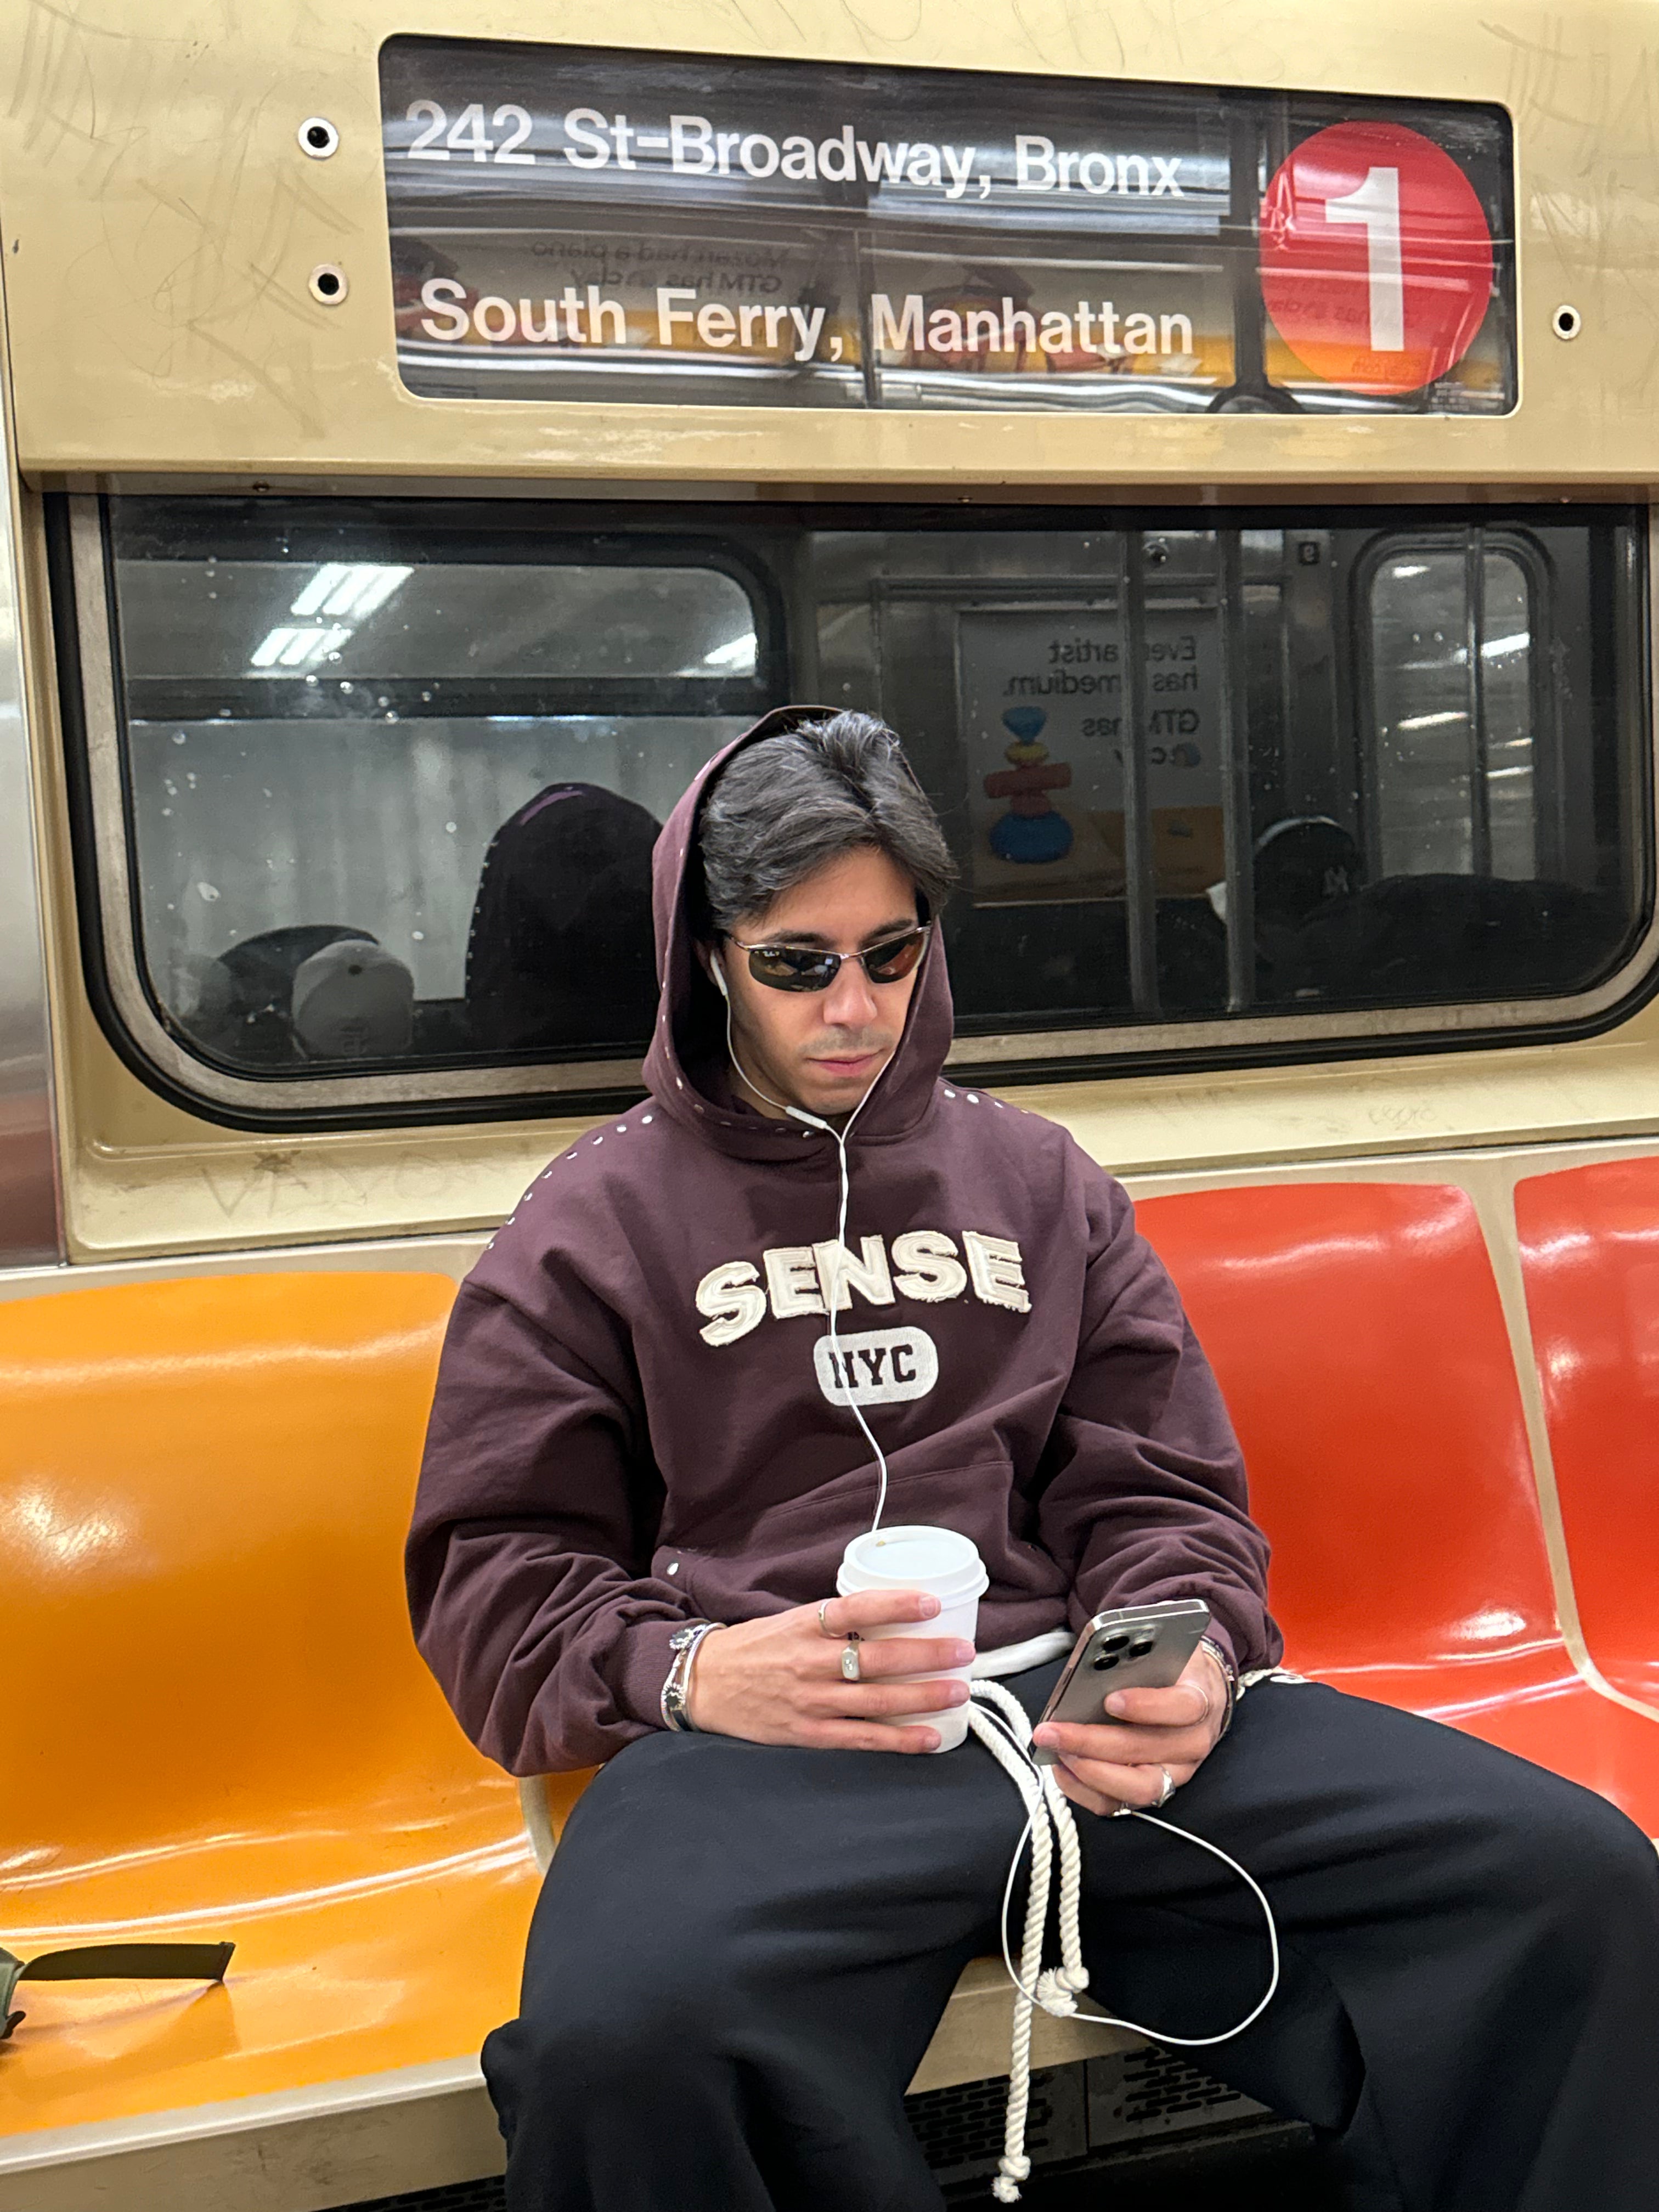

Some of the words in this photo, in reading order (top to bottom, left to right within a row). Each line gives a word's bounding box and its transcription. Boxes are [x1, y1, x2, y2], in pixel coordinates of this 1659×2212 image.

[406, 99, 535, 165] 242
[1015, 135, 1184, 197] Bronx
[1325, 167, 1404, 351] 1
[421, 279, 626, 344] South
[657, 288, 843, 362] Ferry,
[871, 294, 1192, 354] Manhattan
[695, 1230, 1032, 1347] SENSE
[828, 1344, 917, 1389] NYC
